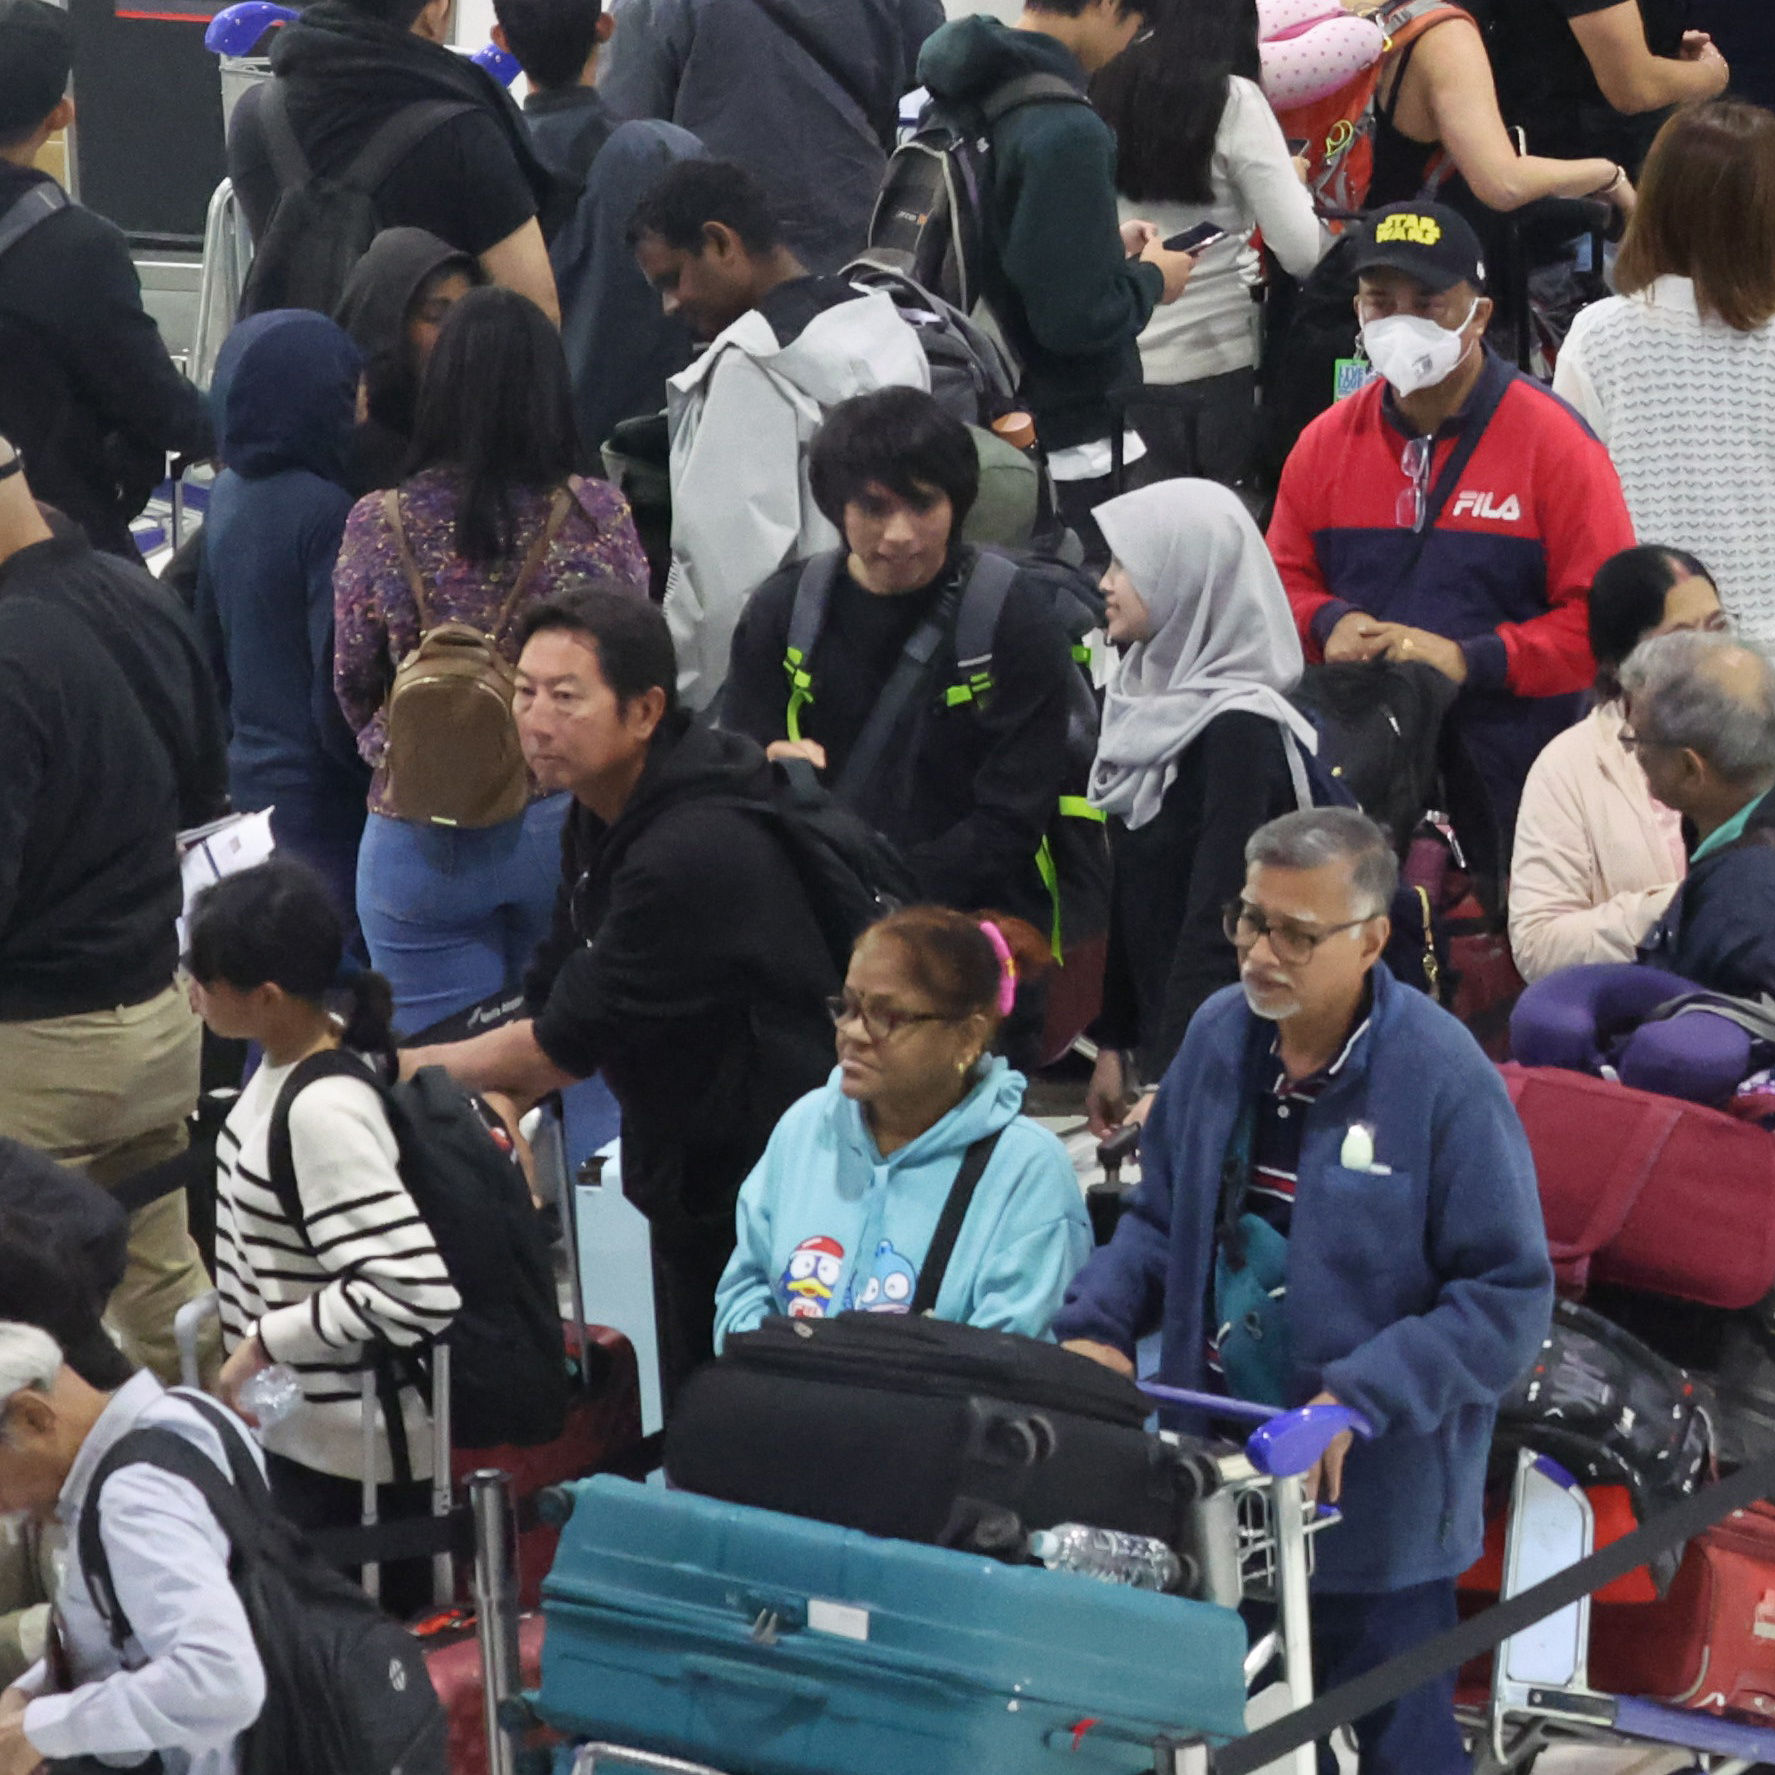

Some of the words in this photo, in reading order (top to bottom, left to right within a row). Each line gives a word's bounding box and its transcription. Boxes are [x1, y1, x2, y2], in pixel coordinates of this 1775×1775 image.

[1384, 213, 1437, 231] STAR
[1376, 224, 1441, 245] WARS
[1452, 490, 1520, 521] FILA
